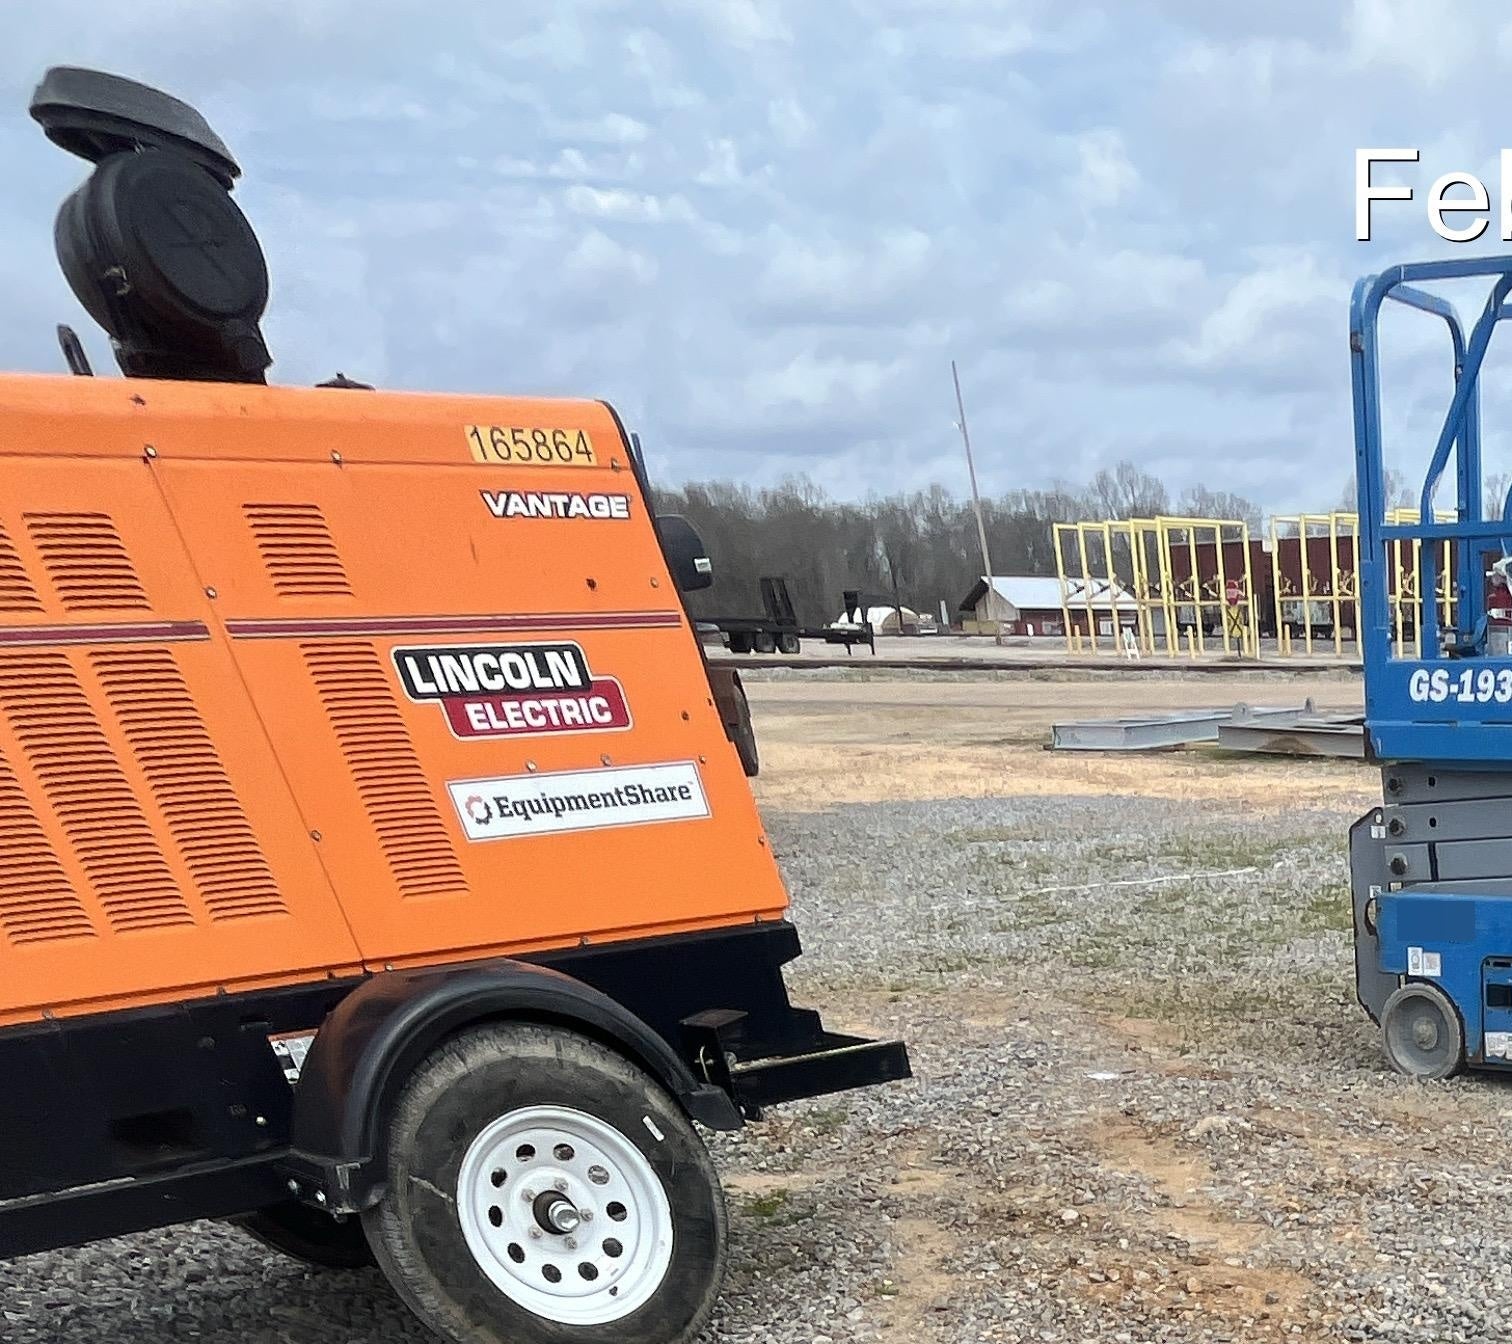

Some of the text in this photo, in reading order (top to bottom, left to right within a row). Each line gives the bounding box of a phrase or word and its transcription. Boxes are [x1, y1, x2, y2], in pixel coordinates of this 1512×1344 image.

[470, 425, 592, 463] 165864
[480, 490, 630, 520] VANTAGE
[403, 650, 583, 694] LINCOLN
[465, 696, 614, 732] ELECTRIC
[493, 782, 692, 822] EquipmentShare
